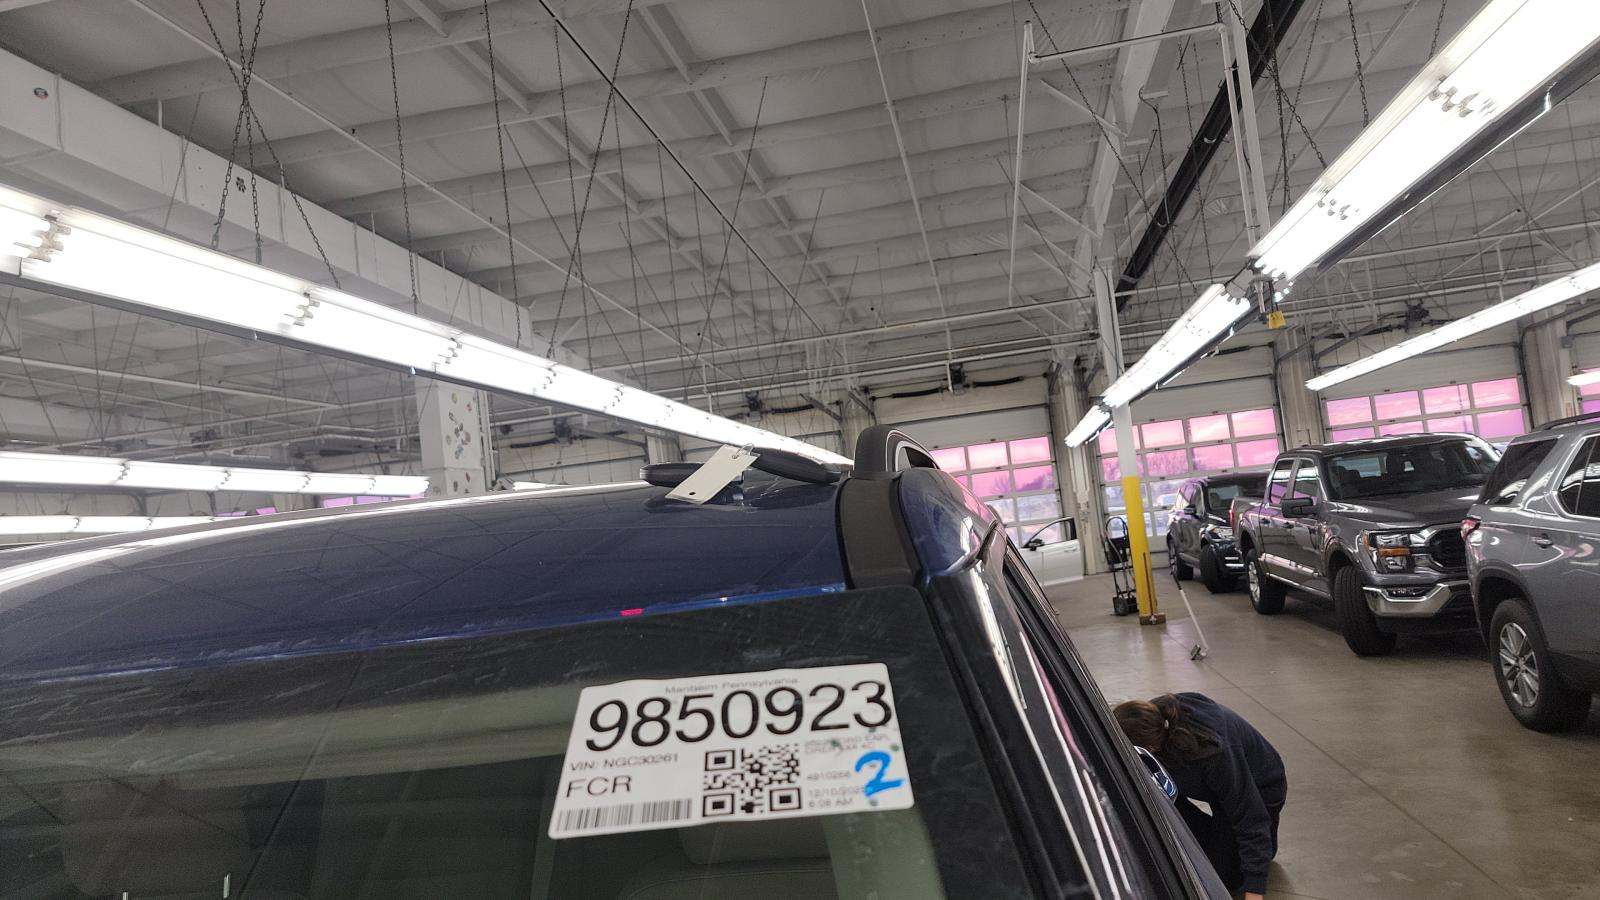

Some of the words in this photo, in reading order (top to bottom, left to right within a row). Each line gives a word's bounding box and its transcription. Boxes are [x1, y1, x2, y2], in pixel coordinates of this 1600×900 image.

[585, 680, 893, 751] 9850923
[566, 775, 632, 798] FCR
[854, 750, 905, 797] 2
